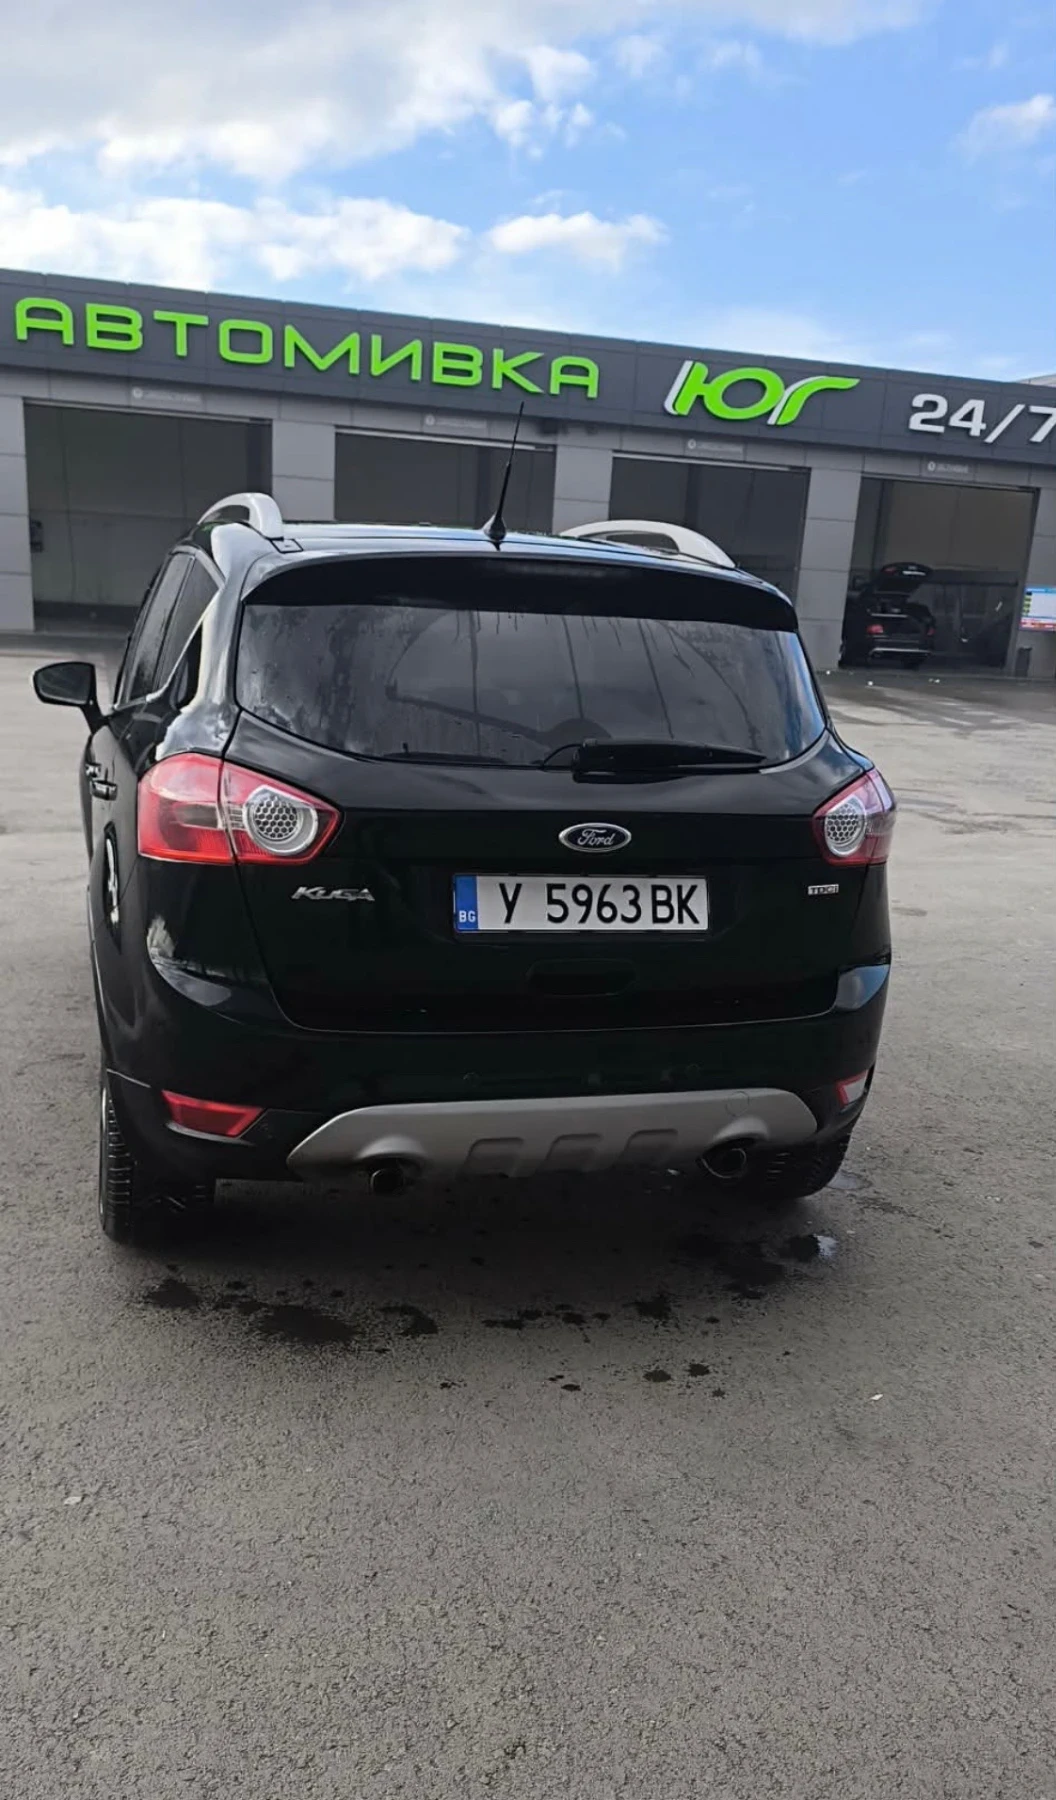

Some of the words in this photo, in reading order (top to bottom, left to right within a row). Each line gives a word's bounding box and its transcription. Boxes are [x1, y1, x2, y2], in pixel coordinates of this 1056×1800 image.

[14, 296, 600, 399] АВТОМИВКА
[908, 393, 1056, 444] 24/7
[577, 828, 616, 846] Ford
[458, 910, 476, 923] BG
